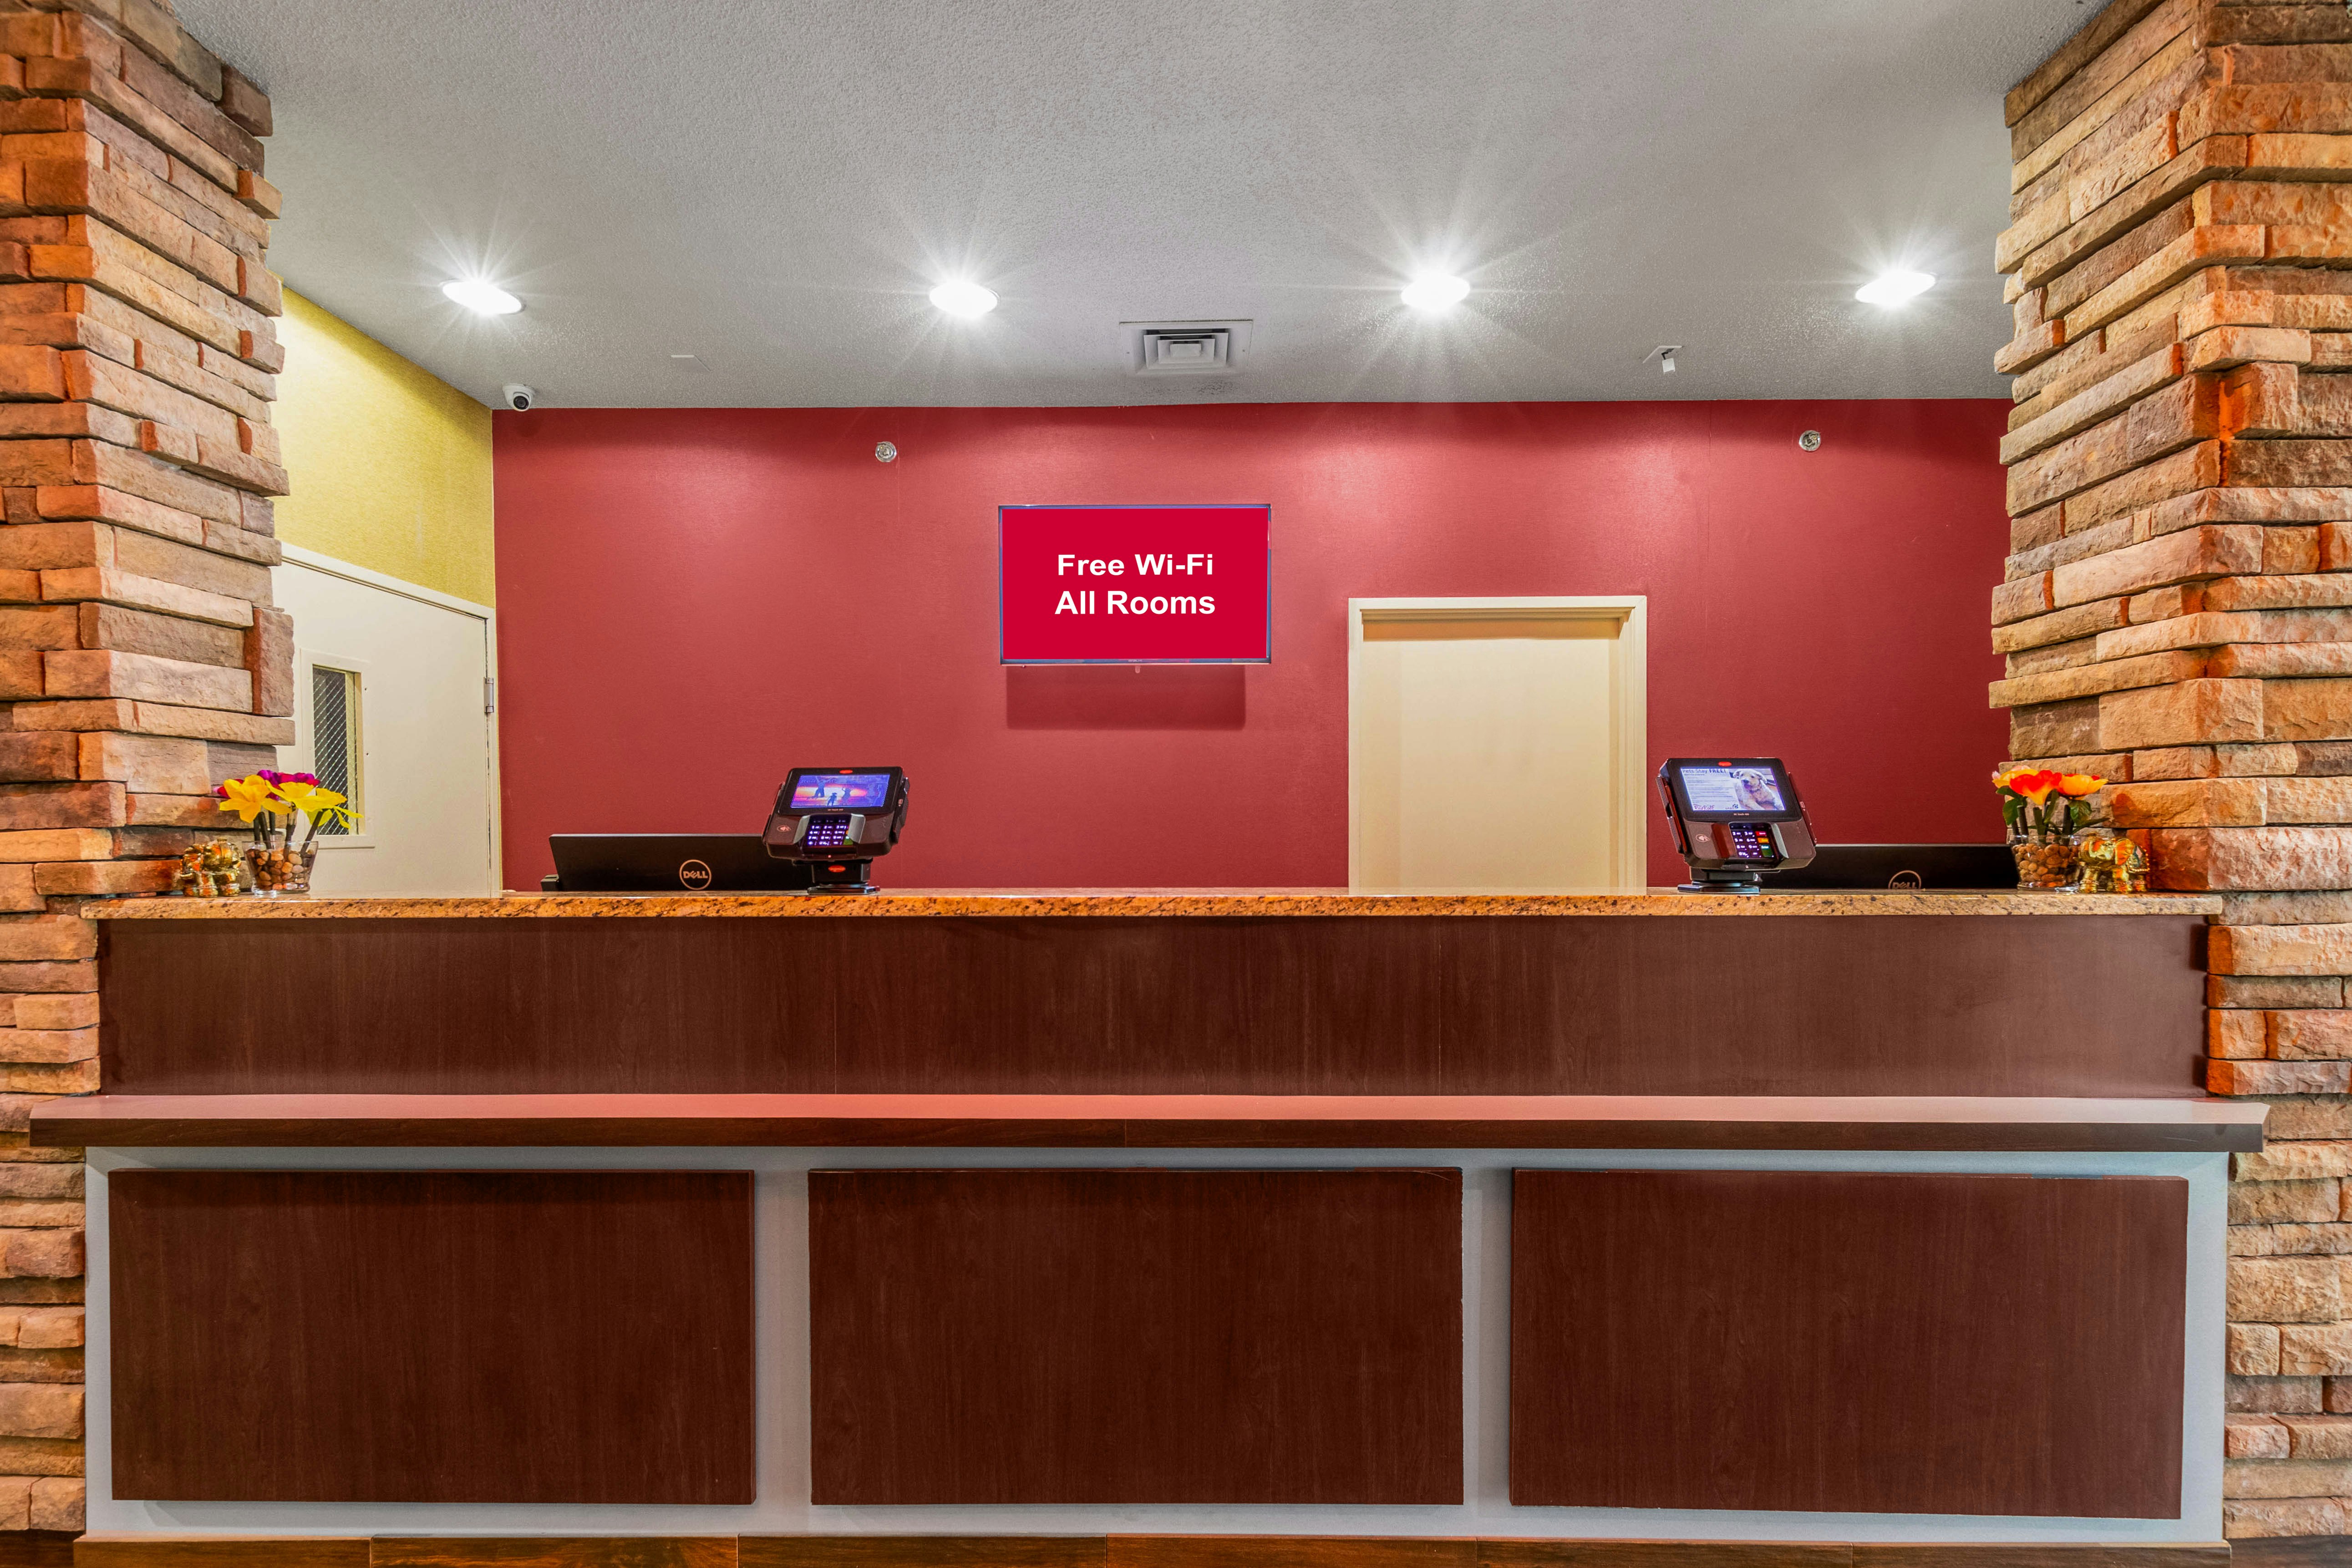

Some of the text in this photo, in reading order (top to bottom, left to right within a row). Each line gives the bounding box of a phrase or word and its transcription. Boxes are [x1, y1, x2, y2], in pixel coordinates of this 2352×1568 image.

[1058, 553, 1213, 576] Free Wi-Fi
[1054, 590, 1215, 614] All Rooms
